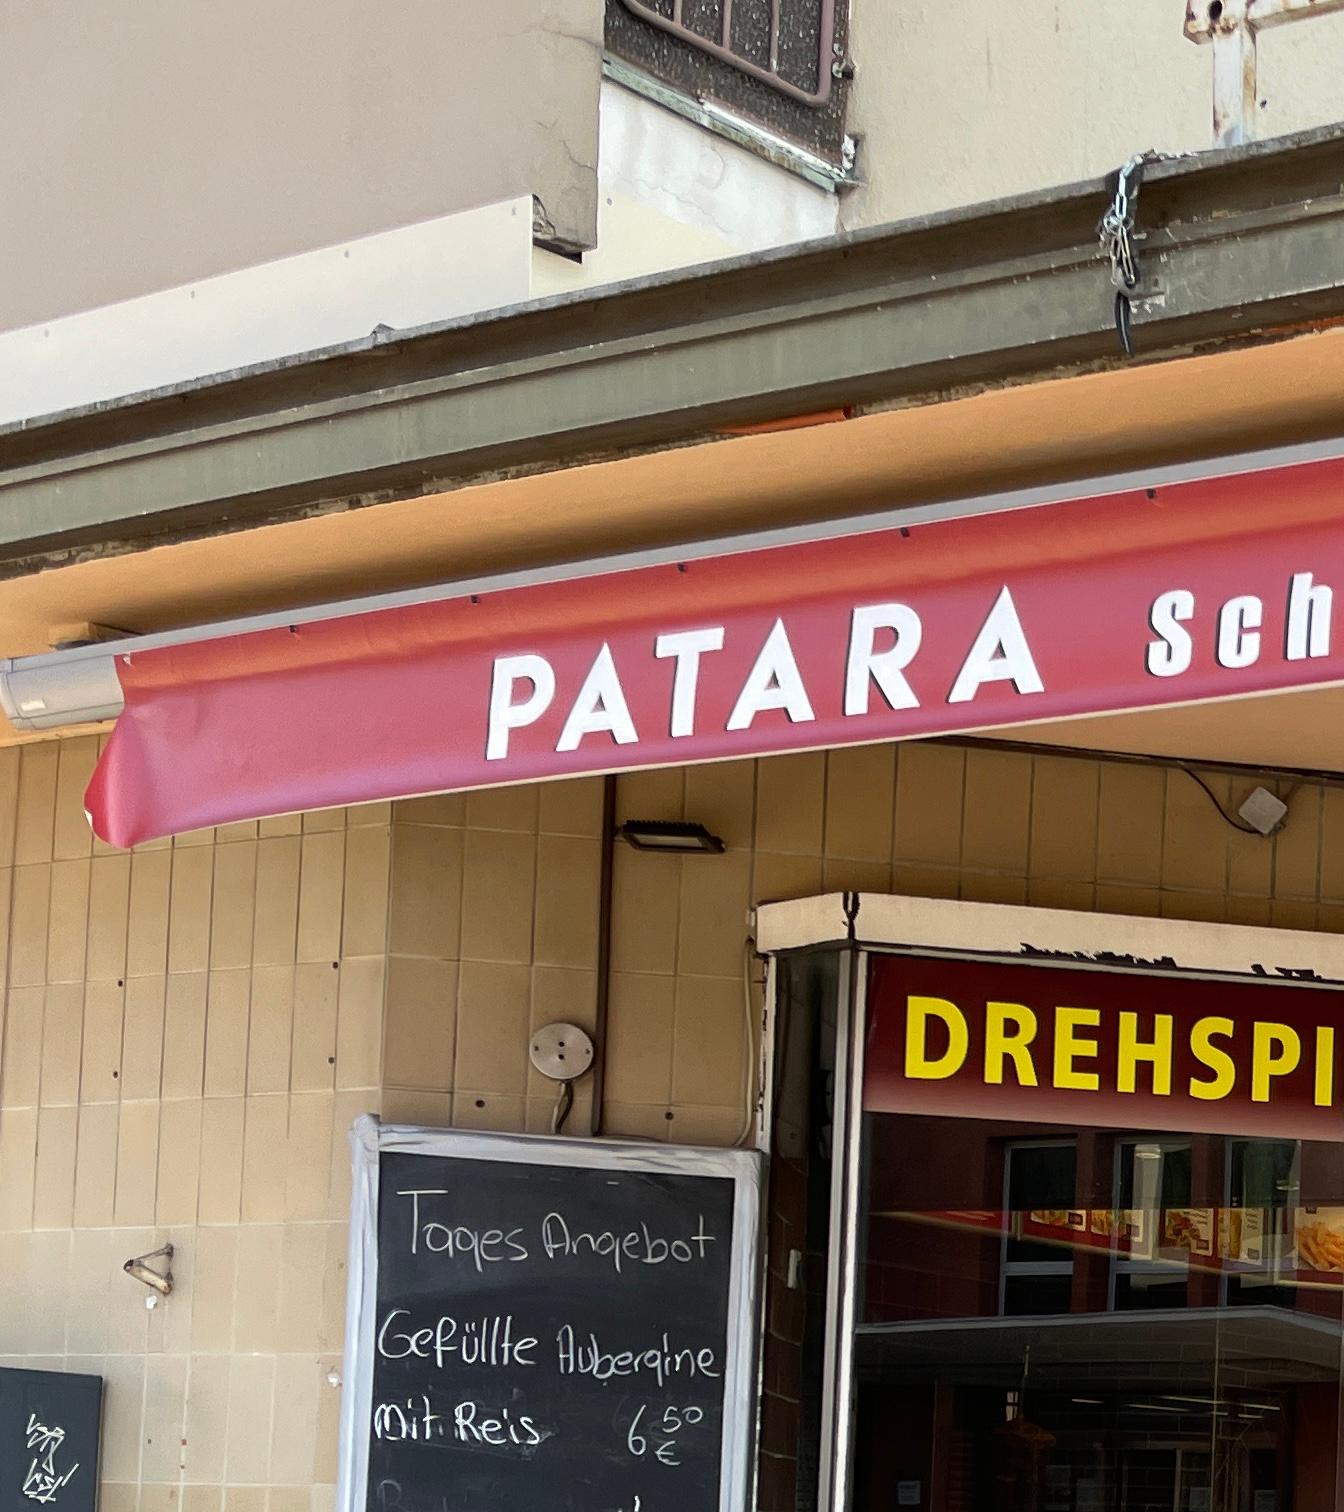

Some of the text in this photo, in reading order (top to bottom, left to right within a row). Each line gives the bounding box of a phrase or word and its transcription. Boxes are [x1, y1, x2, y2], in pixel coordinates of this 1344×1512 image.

[486, 586, 1045, 762] PATARA
[396, 1189, 718, 1274] Tages Angebot
[454, 1401, 541, 1446] Reis
